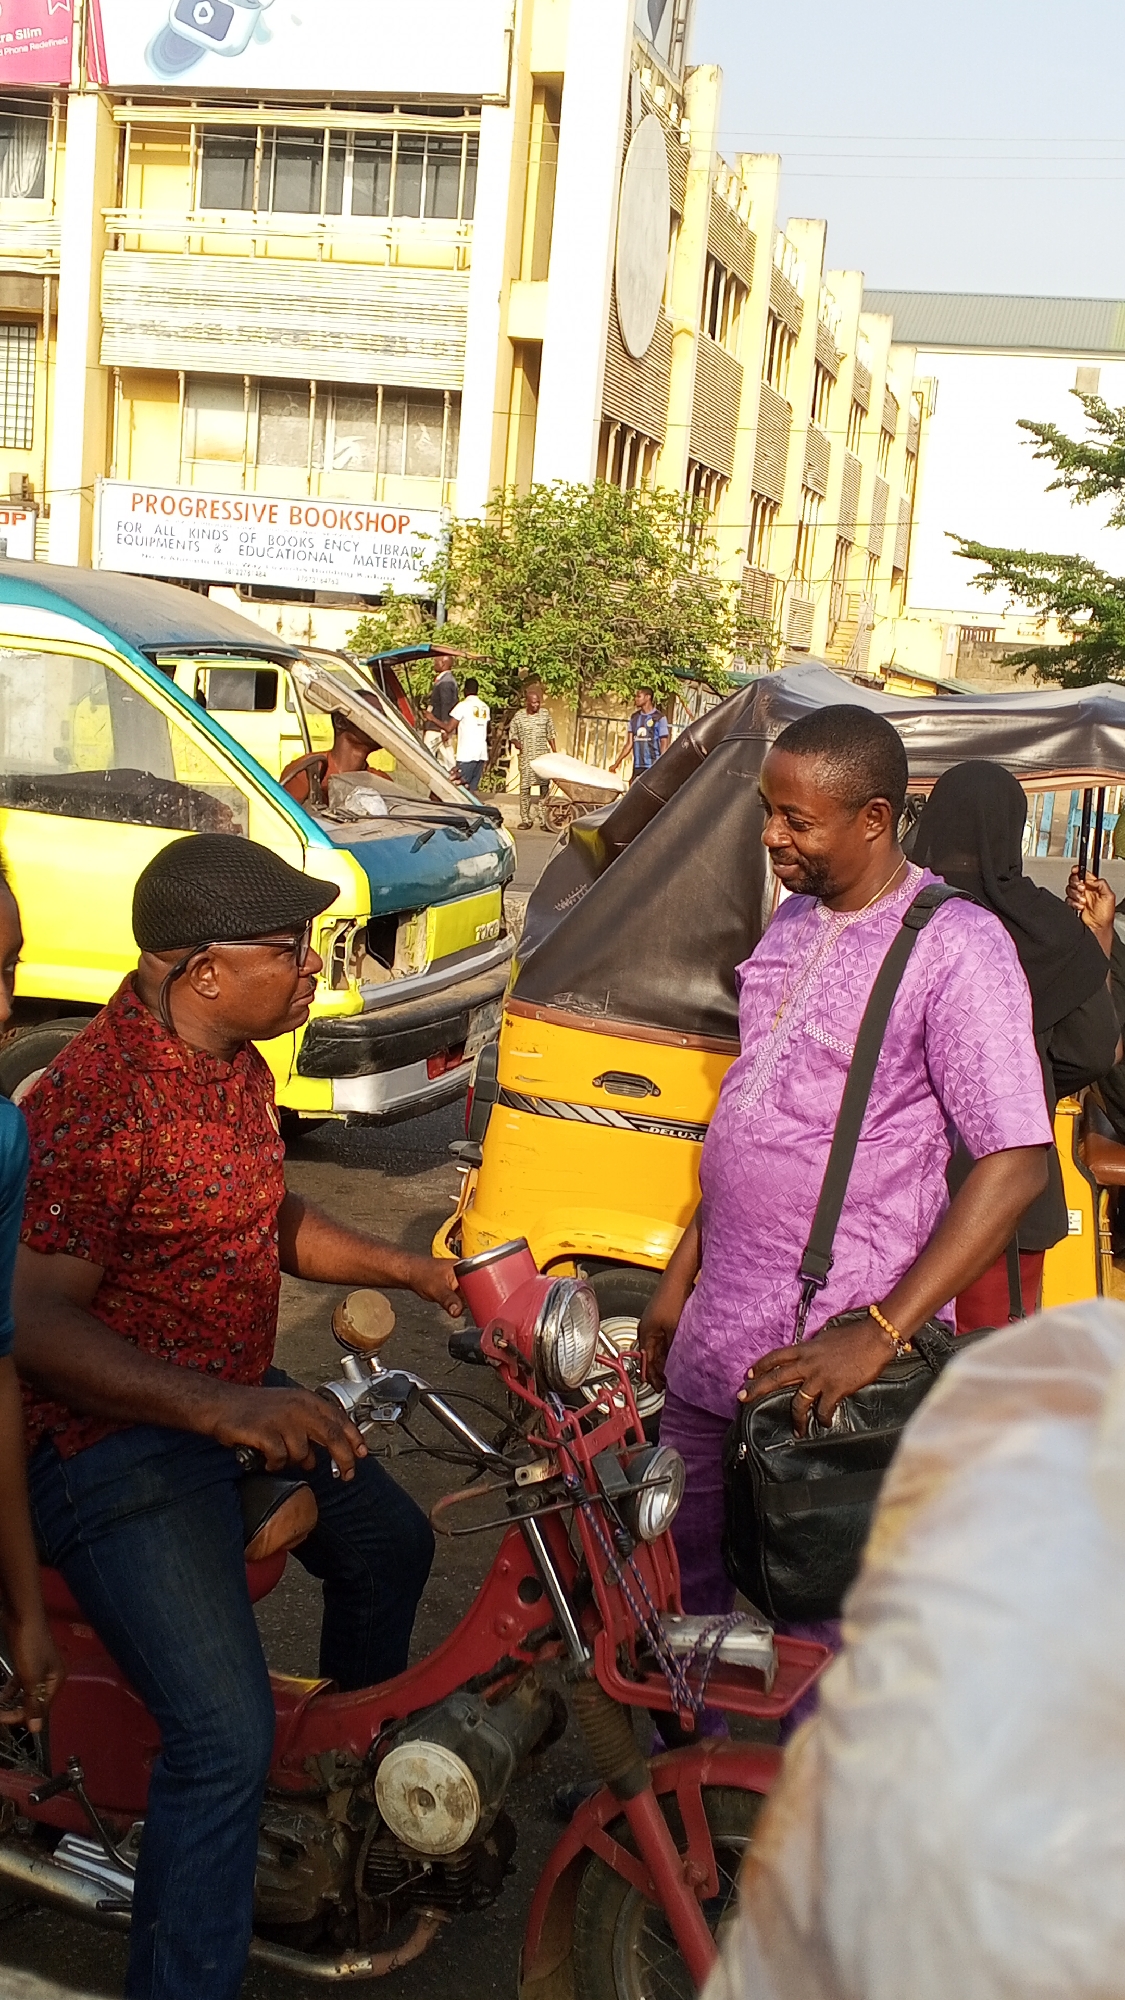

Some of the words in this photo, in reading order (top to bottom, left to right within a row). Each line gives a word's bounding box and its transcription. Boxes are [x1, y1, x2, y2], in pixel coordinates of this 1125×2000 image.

[0, 33, 14, 43] ra
[15, 27, 42, 40] Slim
[4, 45, 29, 55] Phone
[30, 36, 69, 51] Redefined
[131, 492, 279, 524] PROGRESSIVE
[289, 505, 411, 535] BOOKSHOP
[116, 520, 143, 534] FOR
[154, 524, 176, 537] ALL
[189, 527, 229, 542] KINDS
[239, 531, 257, 544] OF
[268, 534, 315, 549] BOOKS
[324, 538, 360, 552] ENCY
[372, 543, 427, 558] LIBRARY
[116, 533, 200, 553] EQUIPMENTS
[214, 542, 222, 554] &
[238, 544, 334, 564] EDUCATIONAL
[353, 554, 427, 572] MATERIALS
[648, 1126, 706, 1141] DELUXE
